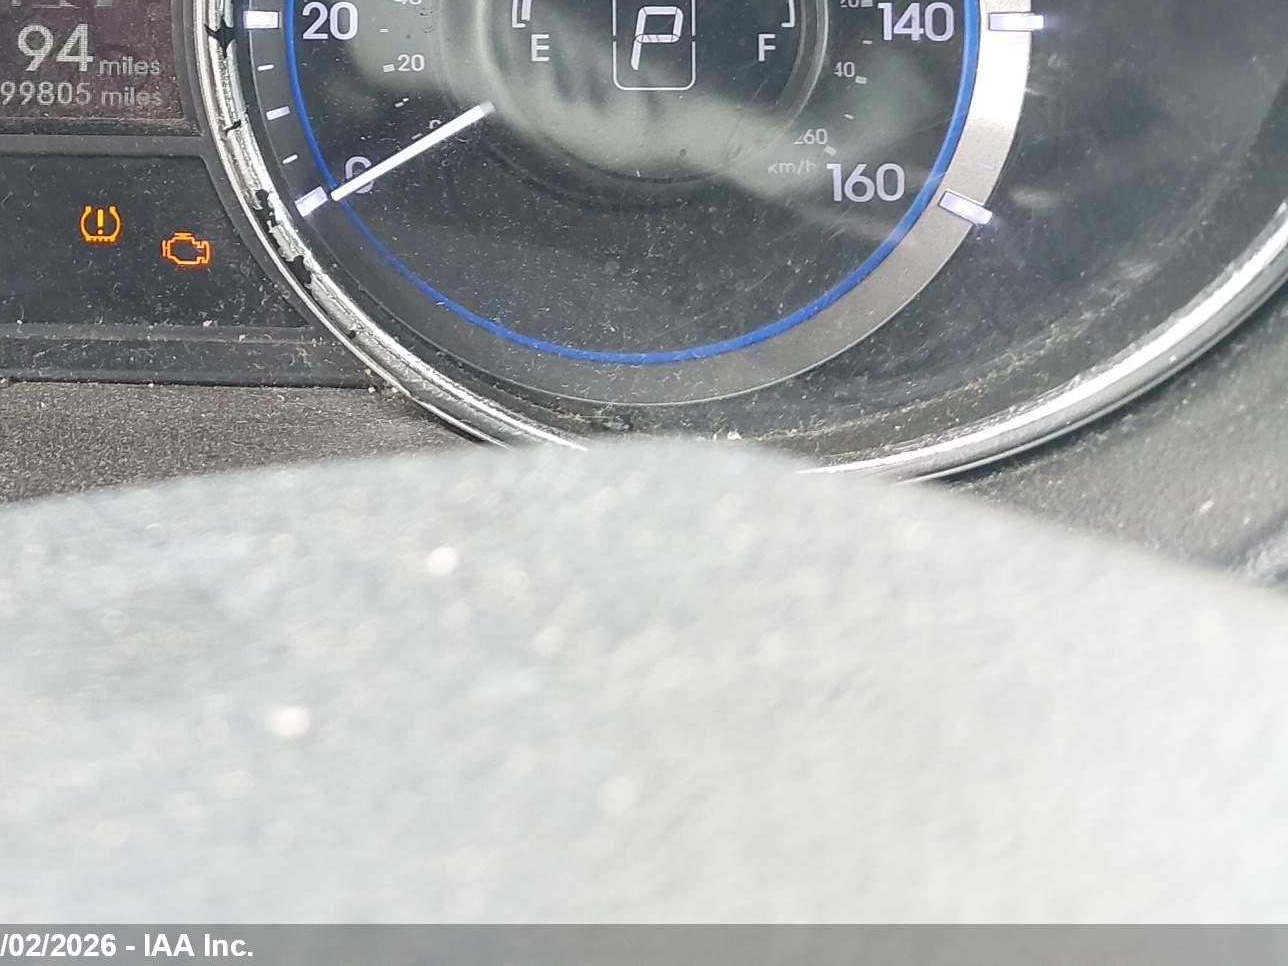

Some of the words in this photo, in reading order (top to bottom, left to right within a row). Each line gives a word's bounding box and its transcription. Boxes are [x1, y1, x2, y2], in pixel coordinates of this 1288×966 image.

[302, 1, 359, 41] 20
[631, 6, 684, 71] P
[877, 2, 954, 42] 140
[17, 23, 94, 72] 94
[99, 56, 160, 76] miles
[397, 54, 425, 72] 20
[531, 34, 550, 62] E
[758, 34, 776, 62] F
[101, 85, 161, 106] miles
[826, 163, 905, 203] 160
